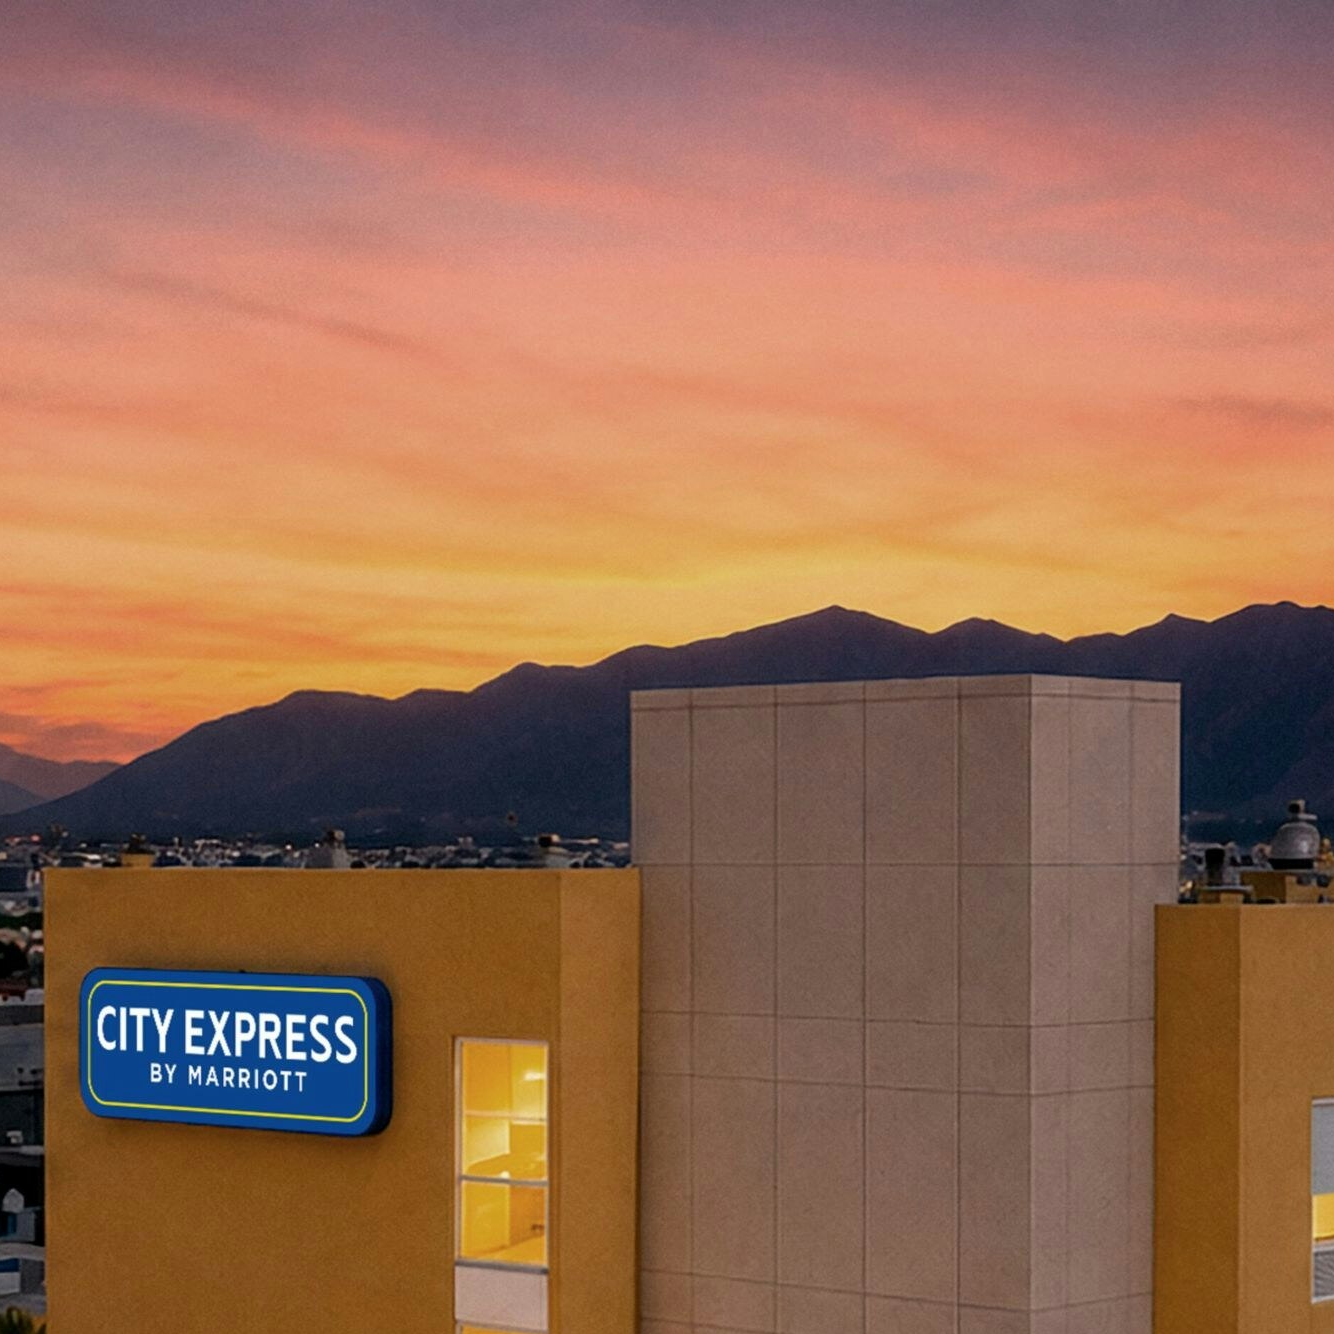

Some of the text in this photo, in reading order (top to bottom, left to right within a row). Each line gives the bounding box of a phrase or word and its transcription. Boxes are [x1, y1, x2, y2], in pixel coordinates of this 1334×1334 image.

[97, 1005, 358, 1064] CITY EXPRESS
[150, 1062, 307, 1092] BY MARRIOTT
